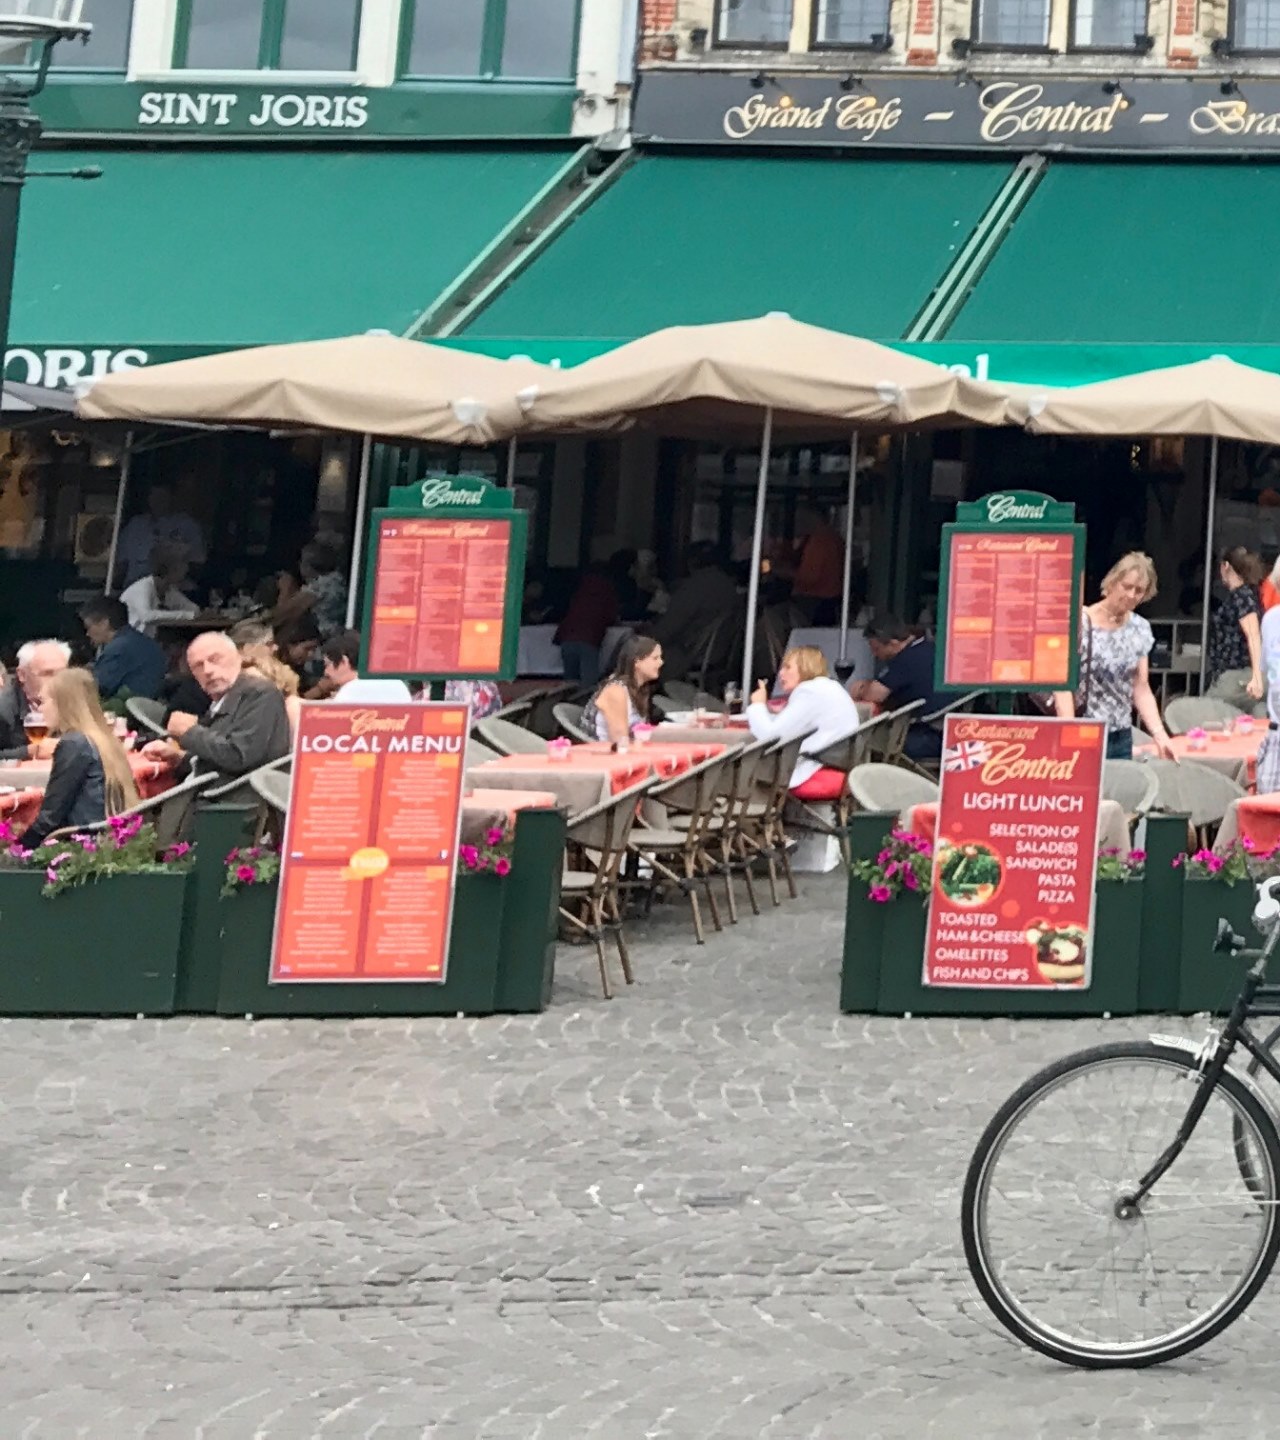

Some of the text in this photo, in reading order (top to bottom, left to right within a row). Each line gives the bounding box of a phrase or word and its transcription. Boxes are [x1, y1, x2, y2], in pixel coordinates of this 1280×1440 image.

[138, 92, 369, 128] SINT JORIS
[723, 94, 833, 139] Grand
[979, 82, 1123, 143] Central
[421, 478, 487, 509] Central
[986, 494, 1049, 523] Central
[301, 734, 463, 753] LOCAL MENU
[981, 740, 1081, 786] Central
[963, 791, 1083, 813] LIGHT LUNCH
[989, 823, 1080, 838] SELECTION OF
[1005, 857, 1077, 870] SANDWICH
[1038, 874, 1076, 887] PASTA
[1037, 890, 1075, 903] PIZZA
[939, 912, 998, 927] TOASTED
[936, 929, 969, 942] HAM
[935, 947, 1009, 962] OMELETTES
[932, 966, 1030, 982] FISH AND CHIPS
